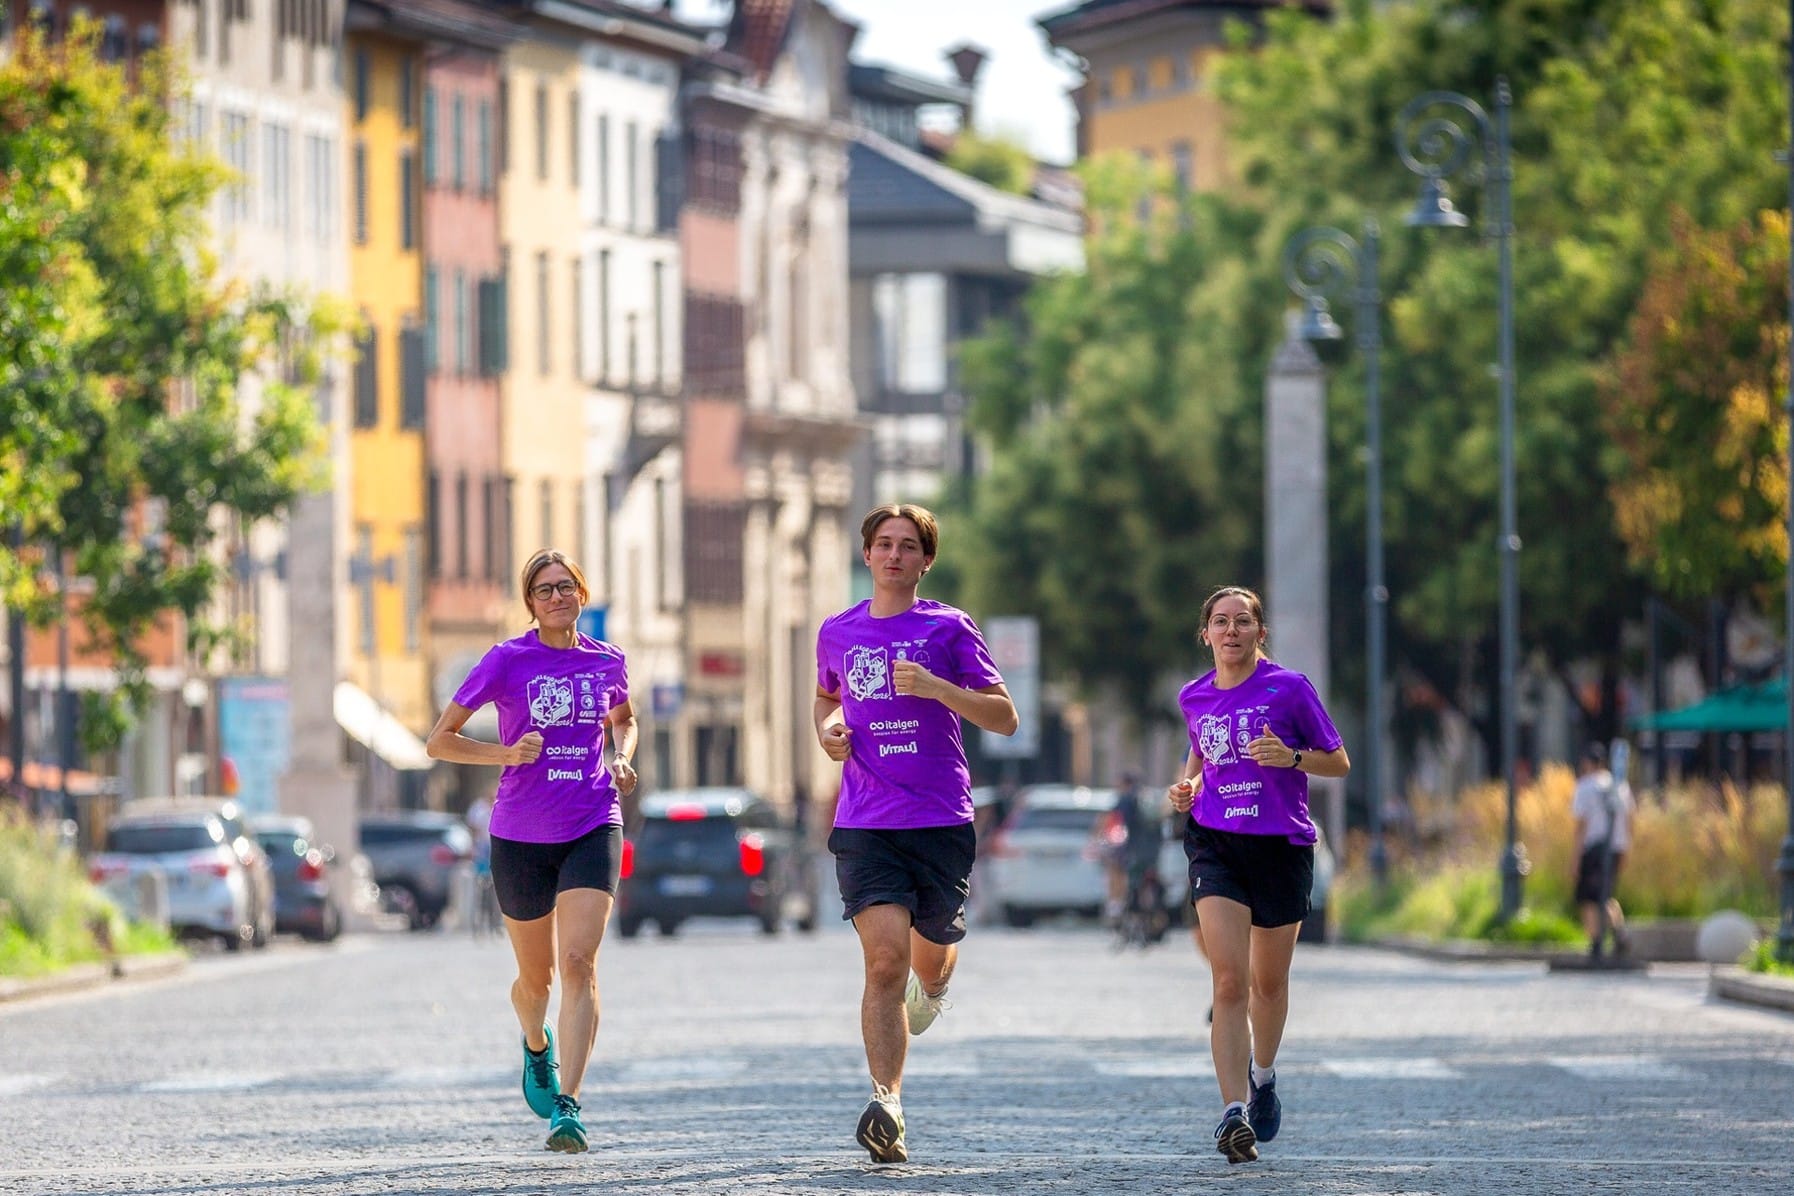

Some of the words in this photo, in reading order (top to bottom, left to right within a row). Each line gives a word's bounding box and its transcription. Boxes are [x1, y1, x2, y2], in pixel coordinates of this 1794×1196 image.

[885, 719, 919, 730] italgen
[562, 745, 588, 756] italgen
[1231, 780, 1262, 792] italgen
